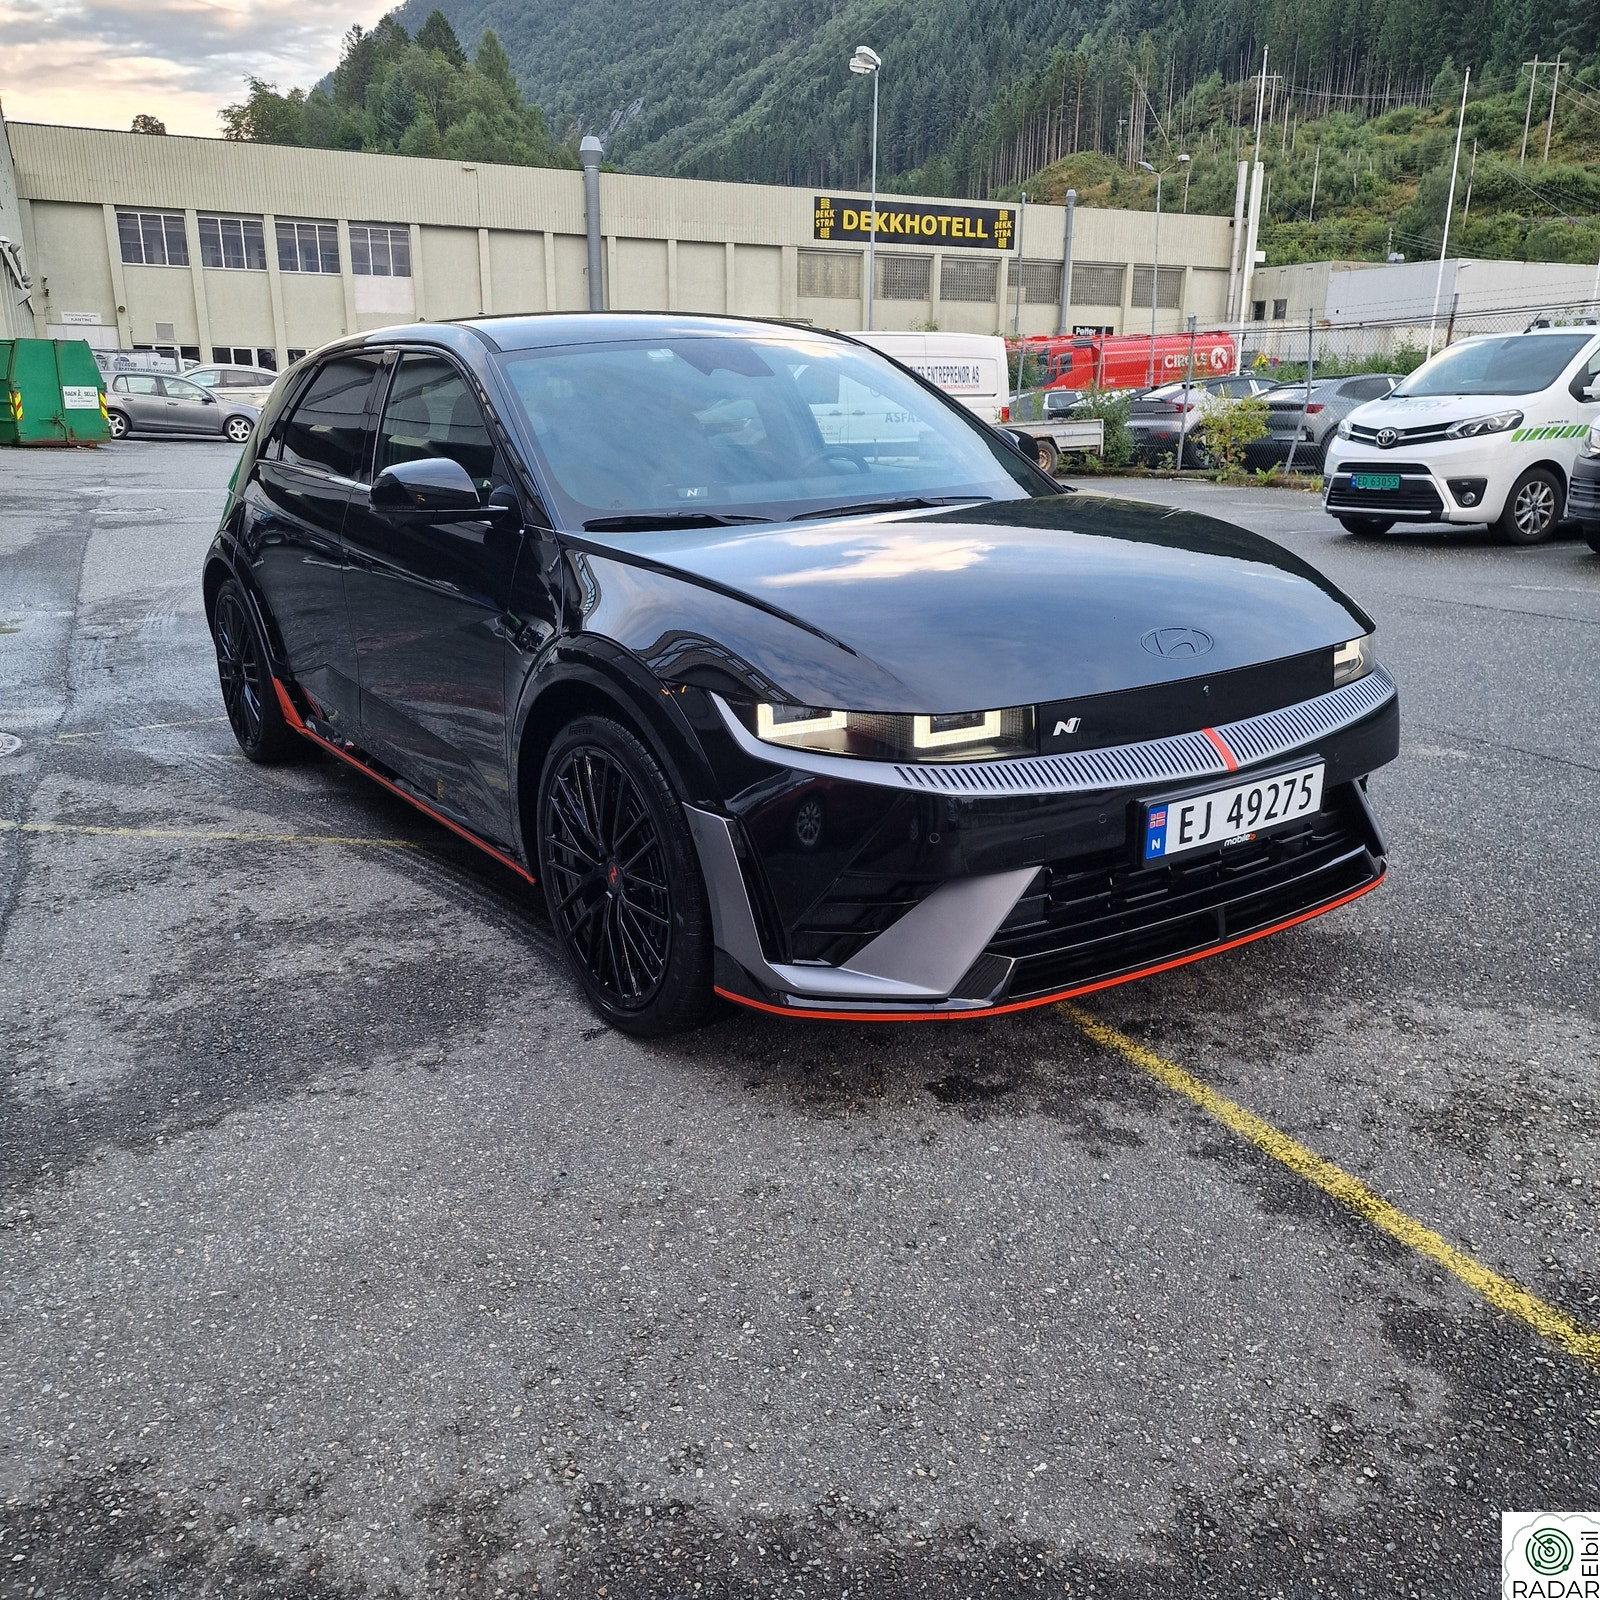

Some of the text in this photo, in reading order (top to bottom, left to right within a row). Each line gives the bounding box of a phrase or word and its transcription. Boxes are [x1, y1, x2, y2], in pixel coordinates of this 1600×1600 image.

[816, 209, 835, 218] DEKK
[815, 218, 834, 227] STRA
[842, 209, 989, 239] DEKKHOTELL
[994, 220, 1012, 229] DEKK
[994, 229, 1011, 238] STRA
[1164, 352, 1207, 368] CIRCLE
[972, 366, 980, 383] AS
[1357, 476, 1368, 486] ED
[1370, 476, 1398, 487] 63055
[1179, 772, 1314, 845] EJ 49275
[1151, 838, 1161, 851] N
